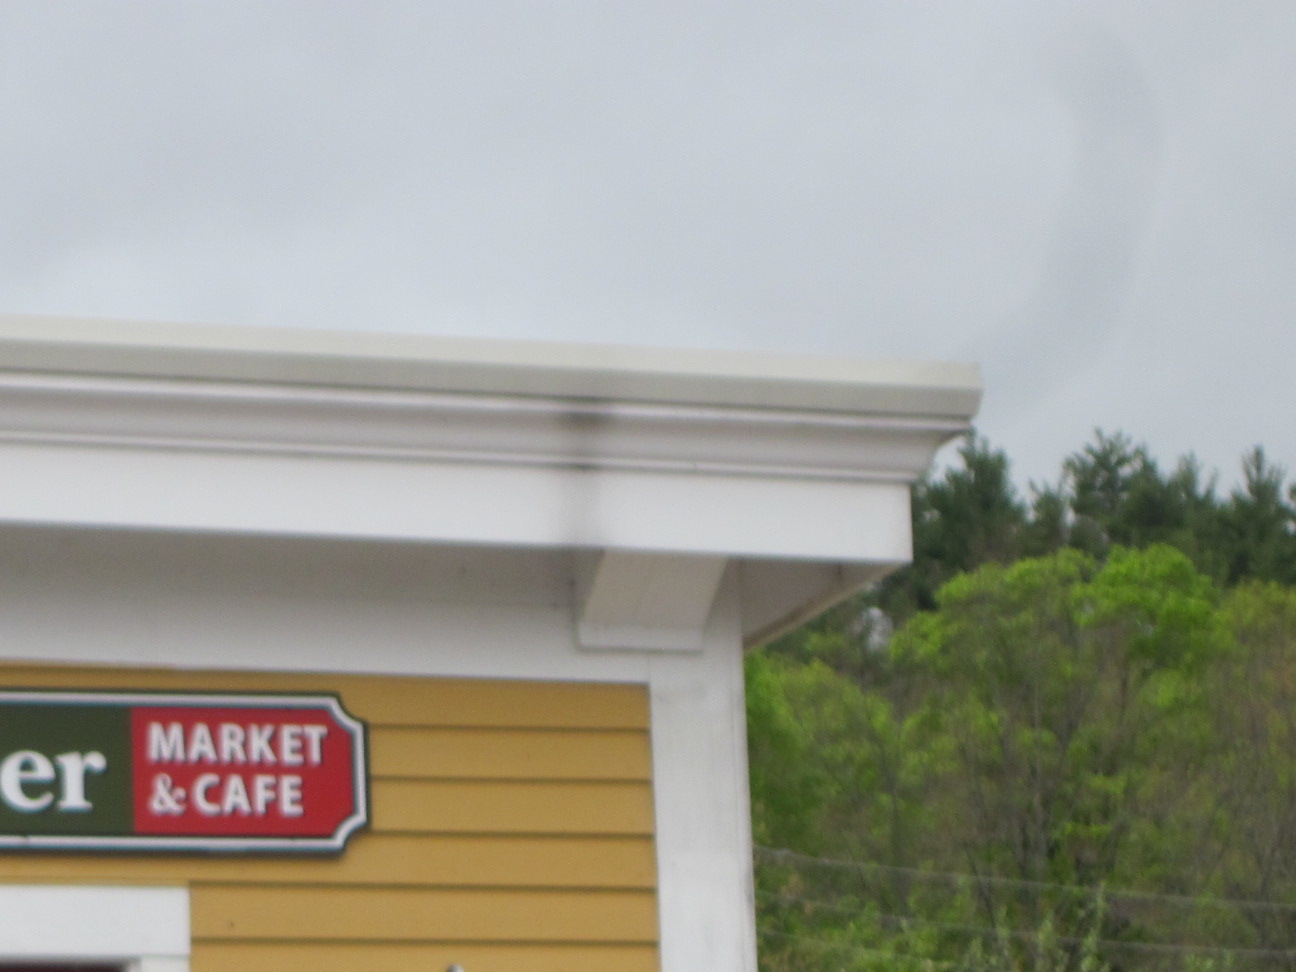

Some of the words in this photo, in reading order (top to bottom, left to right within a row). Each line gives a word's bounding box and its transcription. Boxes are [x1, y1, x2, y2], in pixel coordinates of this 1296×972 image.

[146, 721, 329, 766] MARKET
[148, 774, 187, 815] &
[194, 773, 304, 816] CAFE
